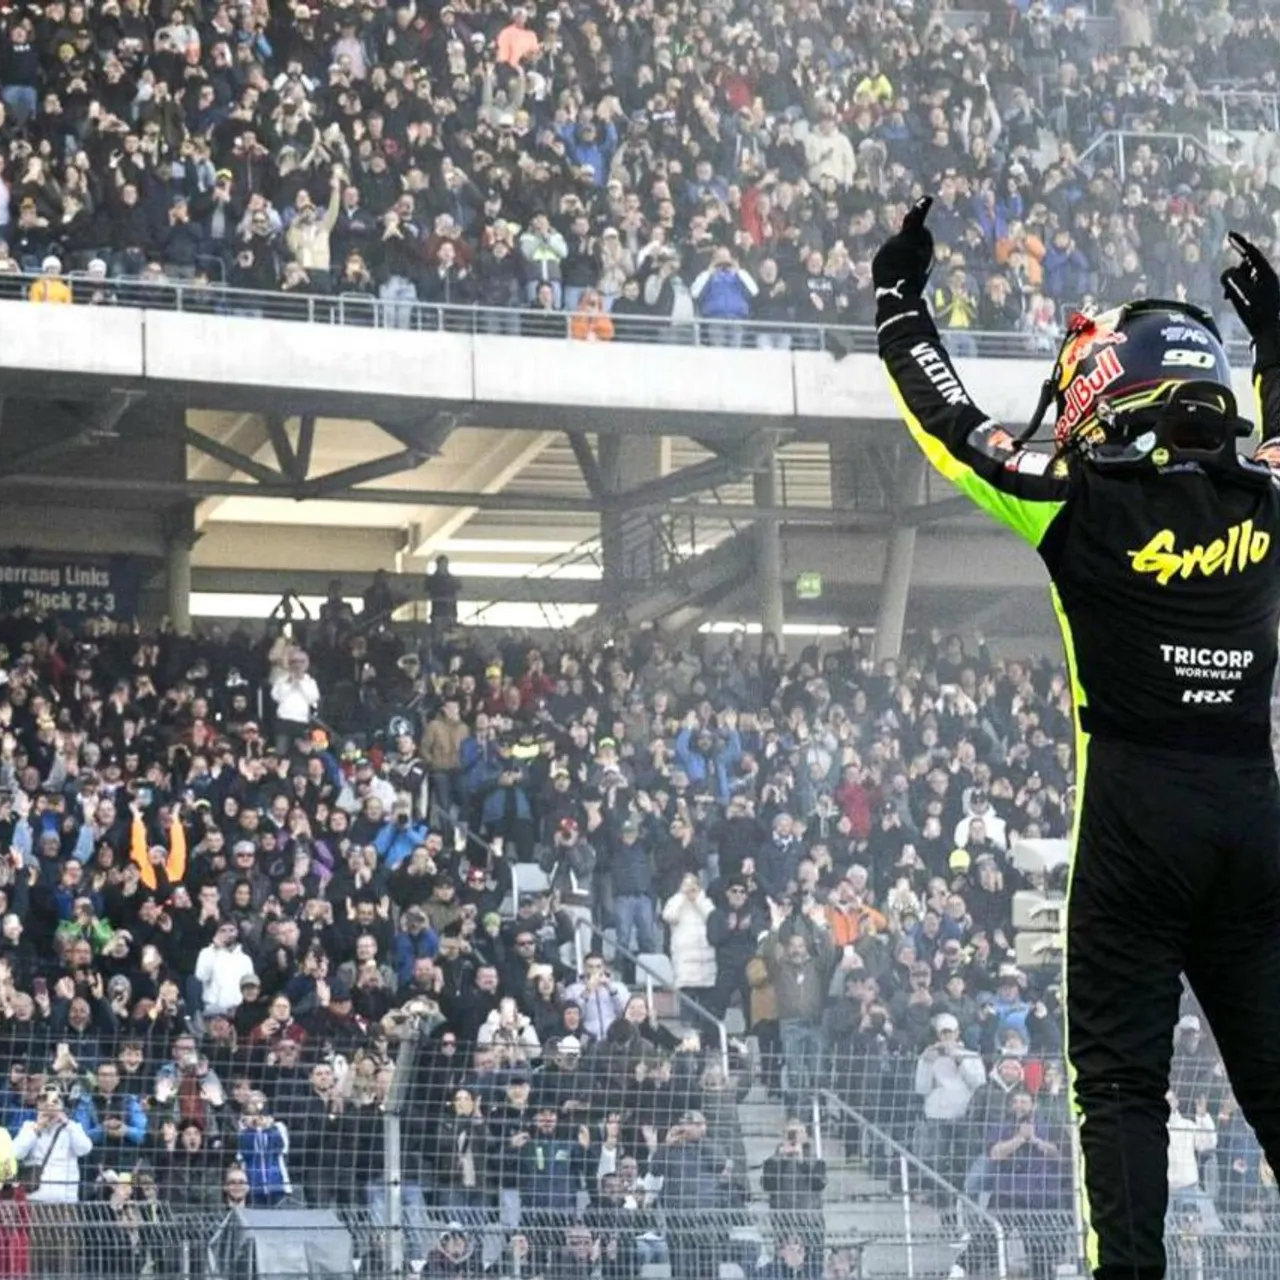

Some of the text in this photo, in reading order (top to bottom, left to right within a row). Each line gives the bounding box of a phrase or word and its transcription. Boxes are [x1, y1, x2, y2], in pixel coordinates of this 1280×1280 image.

[1161, 348, 1217, 369] 90
[910, 342, 971, 406] VELTIN
[1127, 519, 1270, 585] Grello
[65, 566, 110, 588] Links
[1160, 644, 1254, 668] TRICORP
[1174, 666, 1243, 680] WORKWEAR
[1181, 689, 1235, 703] HRX
